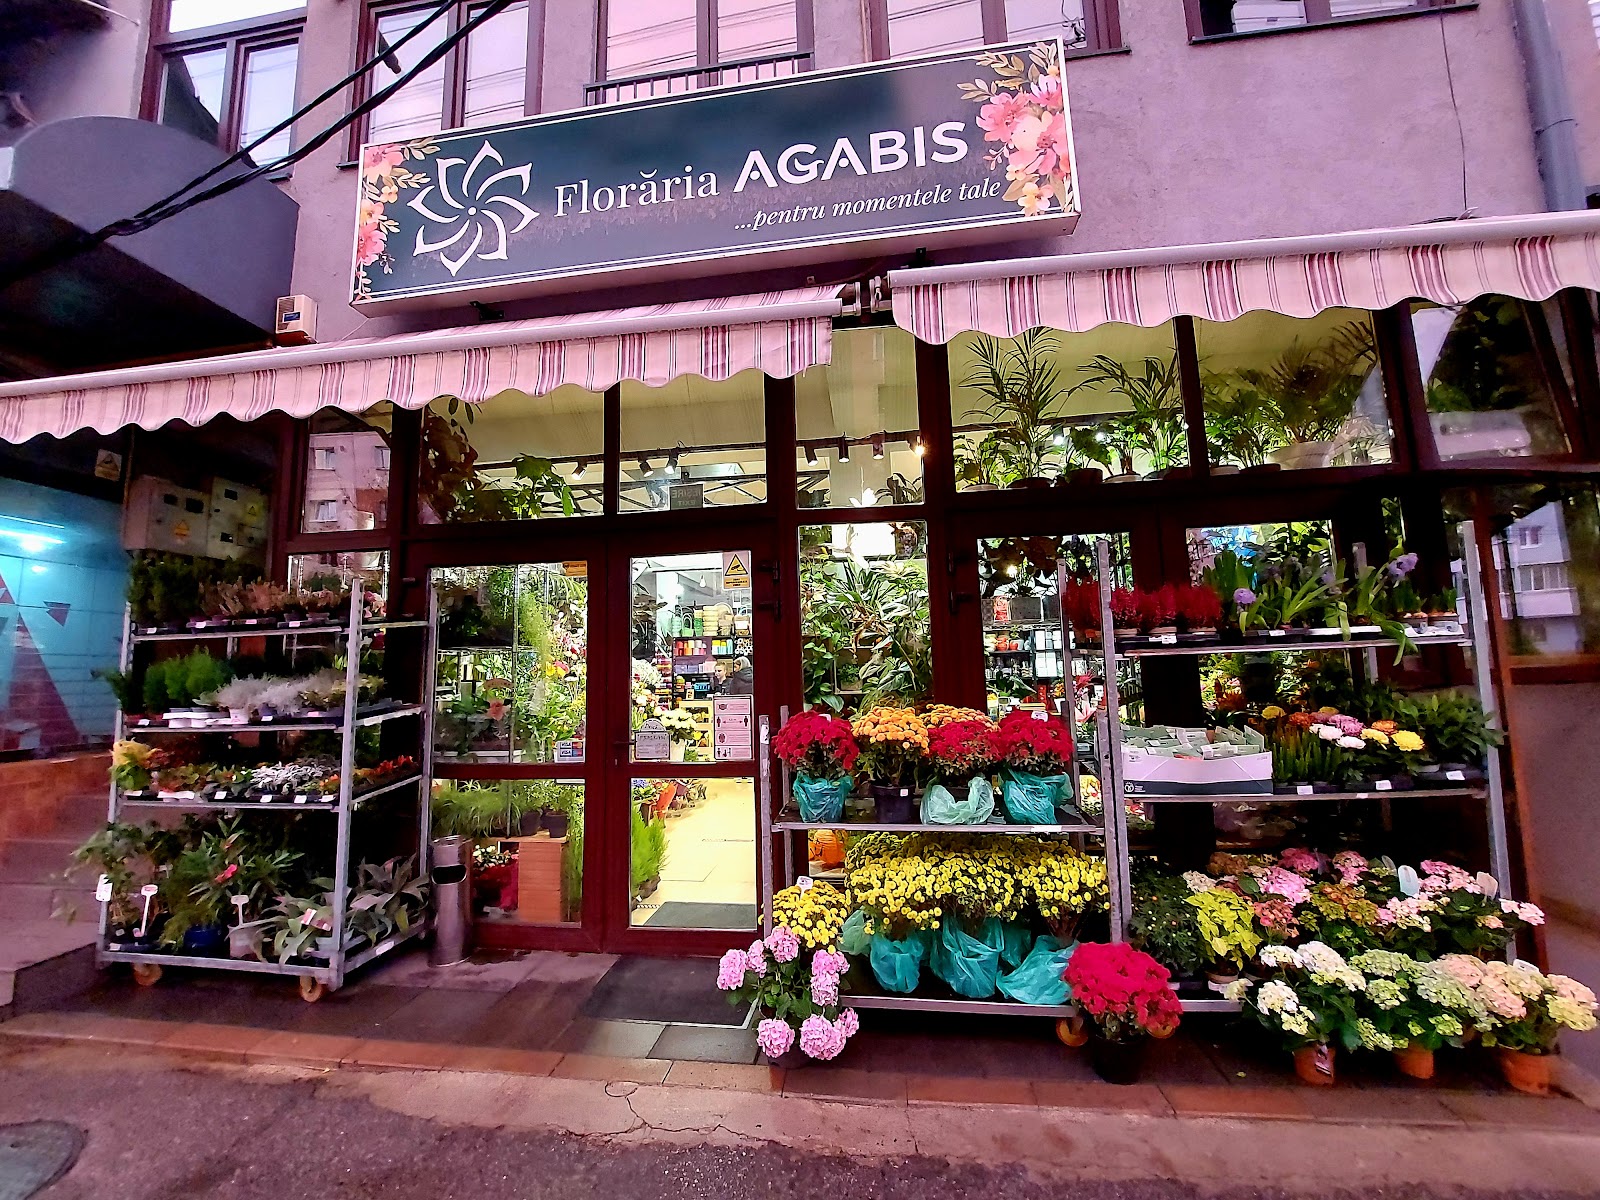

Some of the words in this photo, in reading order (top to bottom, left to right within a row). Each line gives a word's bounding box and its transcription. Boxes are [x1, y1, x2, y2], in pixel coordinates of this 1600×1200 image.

[553, 167, 720, 218] Florăria
[732, 120, 969, 193] AGABIS
[733, 203, 826, 231] ...pentru
[832, 184, 952, 217] momentele
[959, 177, 1002, 201] tale
